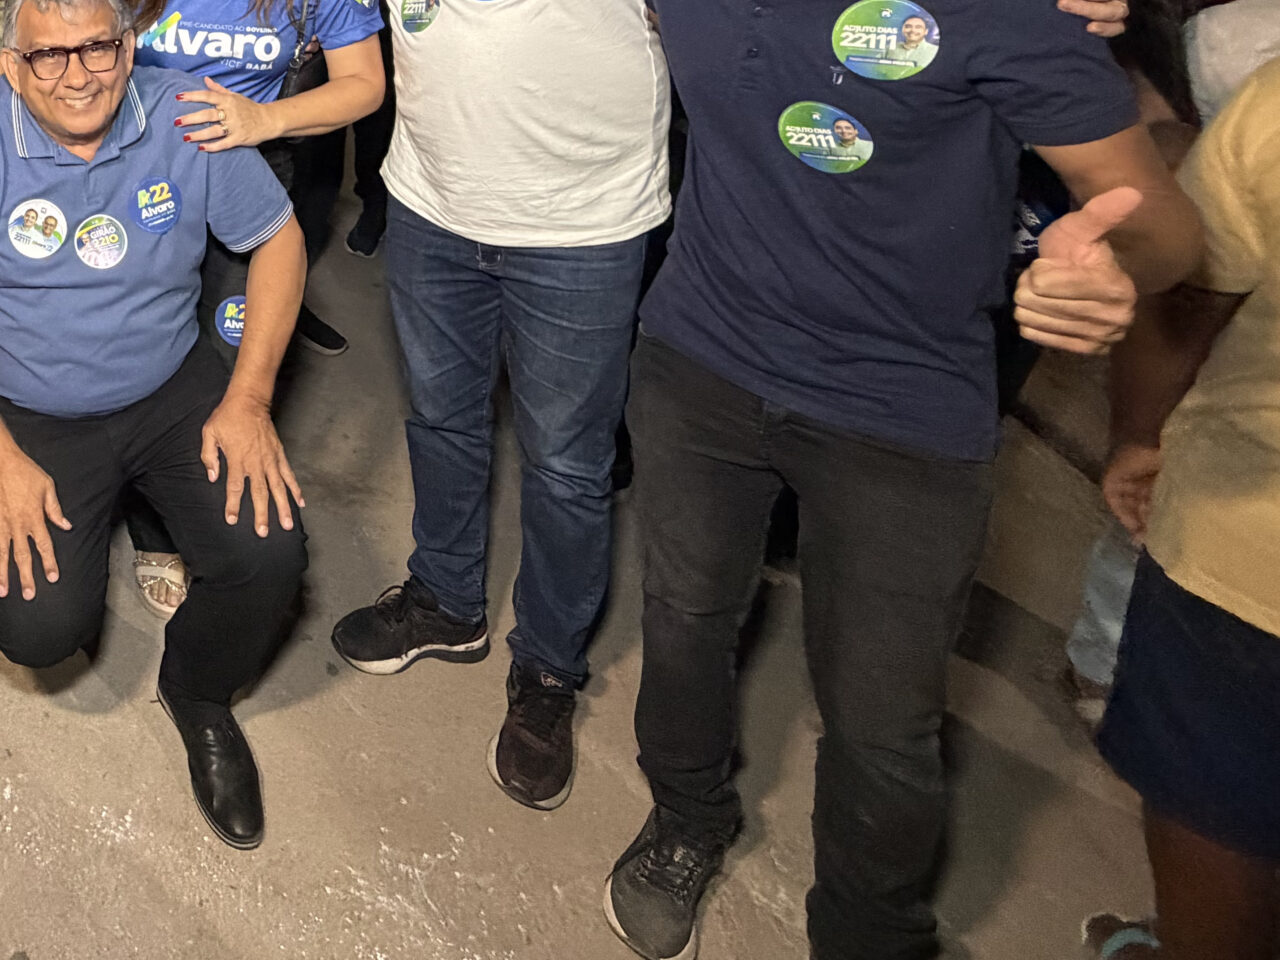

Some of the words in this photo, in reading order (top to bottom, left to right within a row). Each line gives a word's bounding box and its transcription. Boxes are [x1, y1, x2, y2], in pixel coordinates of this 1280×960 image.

[136, 11, 281, 62] Alvaro
[843, 25, 876, 33] ADJUTO
[877, 26, 898, 34] DIAS
[840, 31, 897, 50] 22111
[786, 131, 836, 148] 22111
[141, 200, 175, 220] Alvaro
